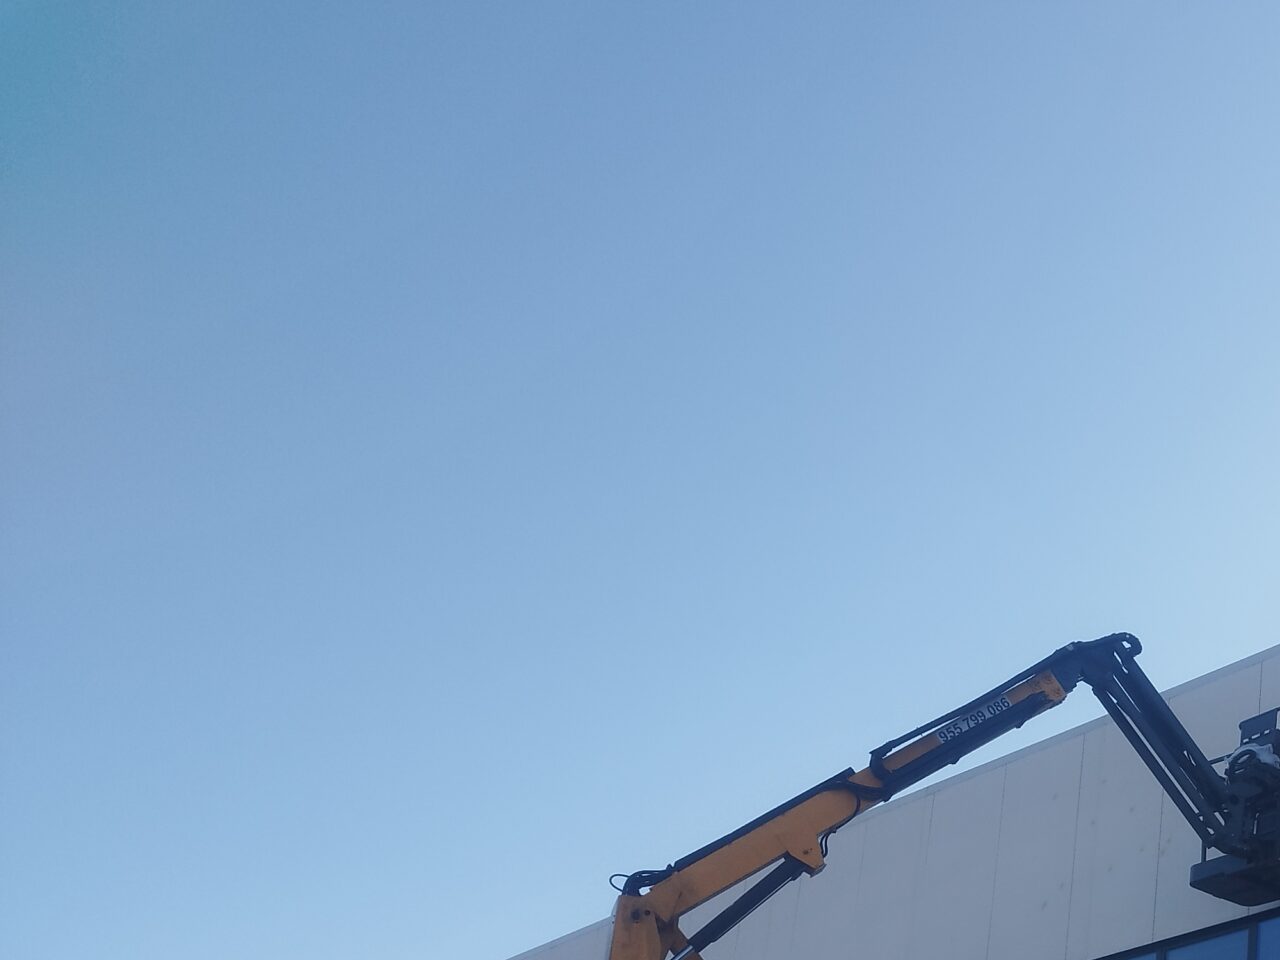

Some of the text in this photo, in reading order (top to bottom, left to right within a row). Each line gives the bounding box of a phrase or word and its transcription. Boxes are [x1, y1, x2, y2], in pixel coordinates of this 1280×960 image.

[938, 697, 1010, 742] 955 799 086
